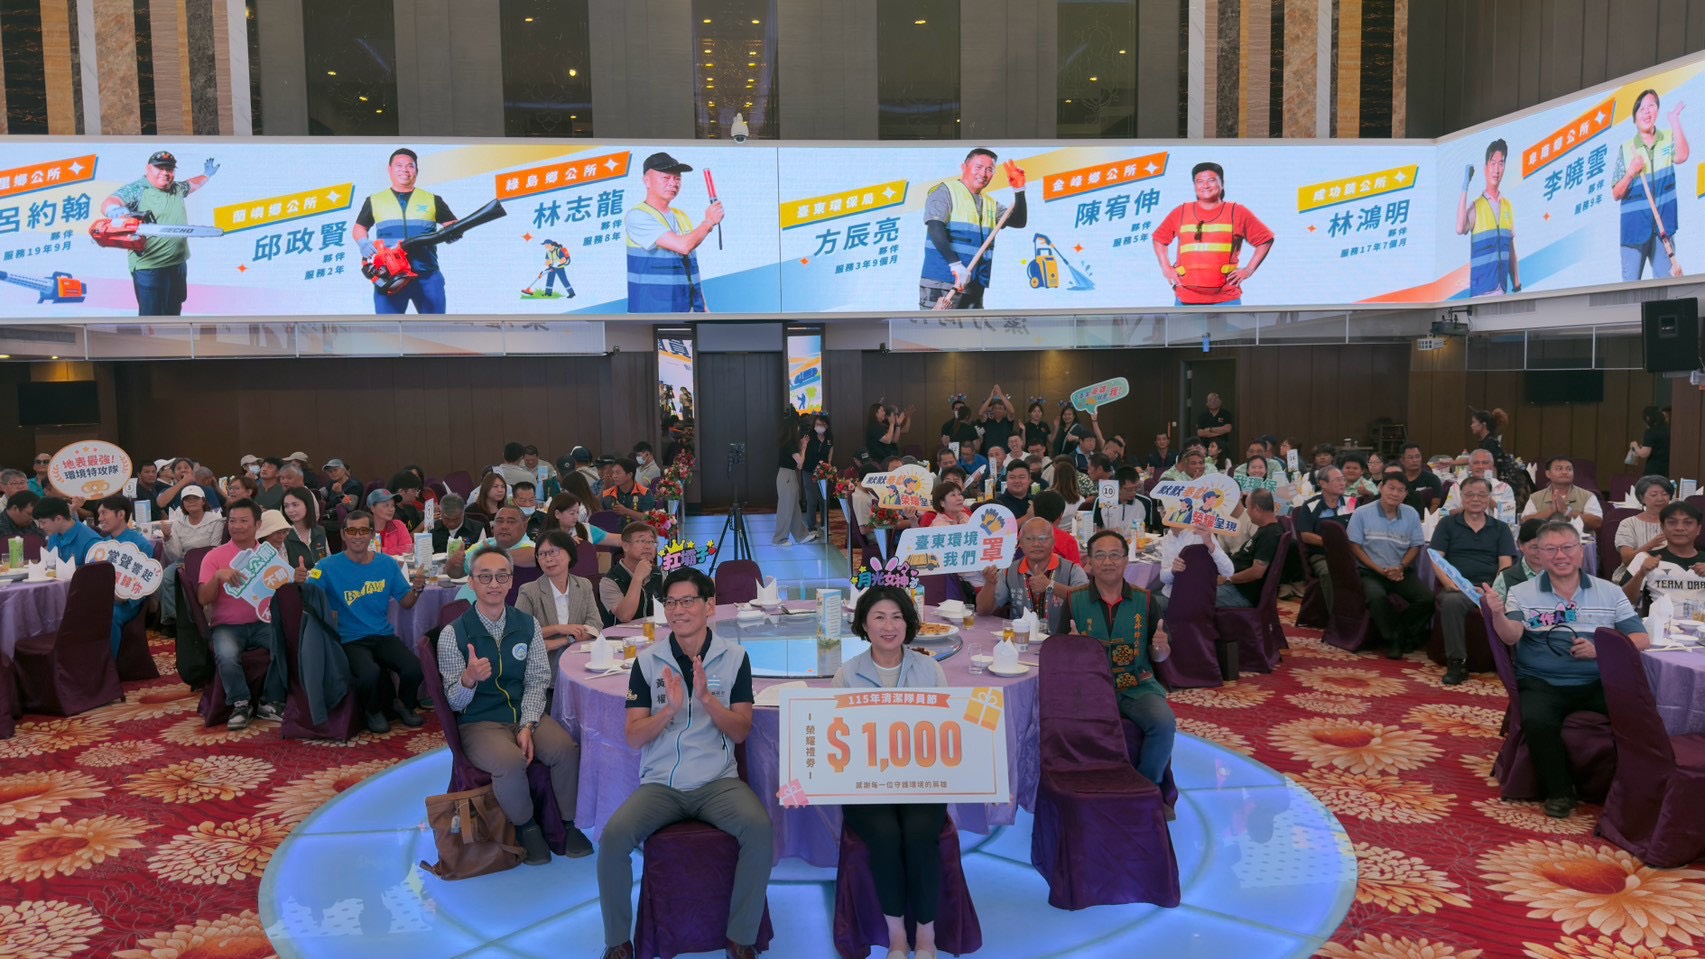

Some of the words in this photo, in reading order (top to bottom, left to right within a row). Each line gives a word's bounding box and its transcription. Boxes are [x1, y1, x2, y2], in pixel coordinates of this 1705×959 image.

[1543, 144, 1607, 201] 李曉雲
[533, 189, 625, 229] 林志龍
[1075, 188, 1160, 228] 陳宥伸
[600, 219, 622, 230] 夥伴
[1328, 199, 1410, 238] 林鴻明
[252, 221, 347, 261] 邱政賢
[583, 232, 621, 246] 服務8年
[813, 217, 900, 256] 方辰亮
[1113, 233, 1149, 247] 服務5年
[3, 241, 72, 260] 服務19年9月
[323, 252, 345, 263] 夥伴
[304, 265, 344, 280] 服務2年
[62, 454, 115, 469] 地表最強!
[64, 465, 118, 479] 環境特攻隊
[901, 494, 933, 507] 榮耀呈
[1192, 511, 1237, 532] 榮耀呈現
[915, 531, 978, 550] 臺東環境
[663, 547, 709, 571] 扛壩子
[943, 550, 976, 567] 我們
[980, 537, 1003, 562] 罩
[857, 571, 909, 592] 月光女神
[1656, 580, 1683, 589] TEAM
[1528, 610, 1576, 629] 工作人員
[848, 693, 938, 705] 115年清潔隊員節
[806, 725, 816, 768] 榮耀禮券
[827, 717, 963, 773] $1,000
[855, 781, 948, 789] 感謝每一位守護環境的英雄
